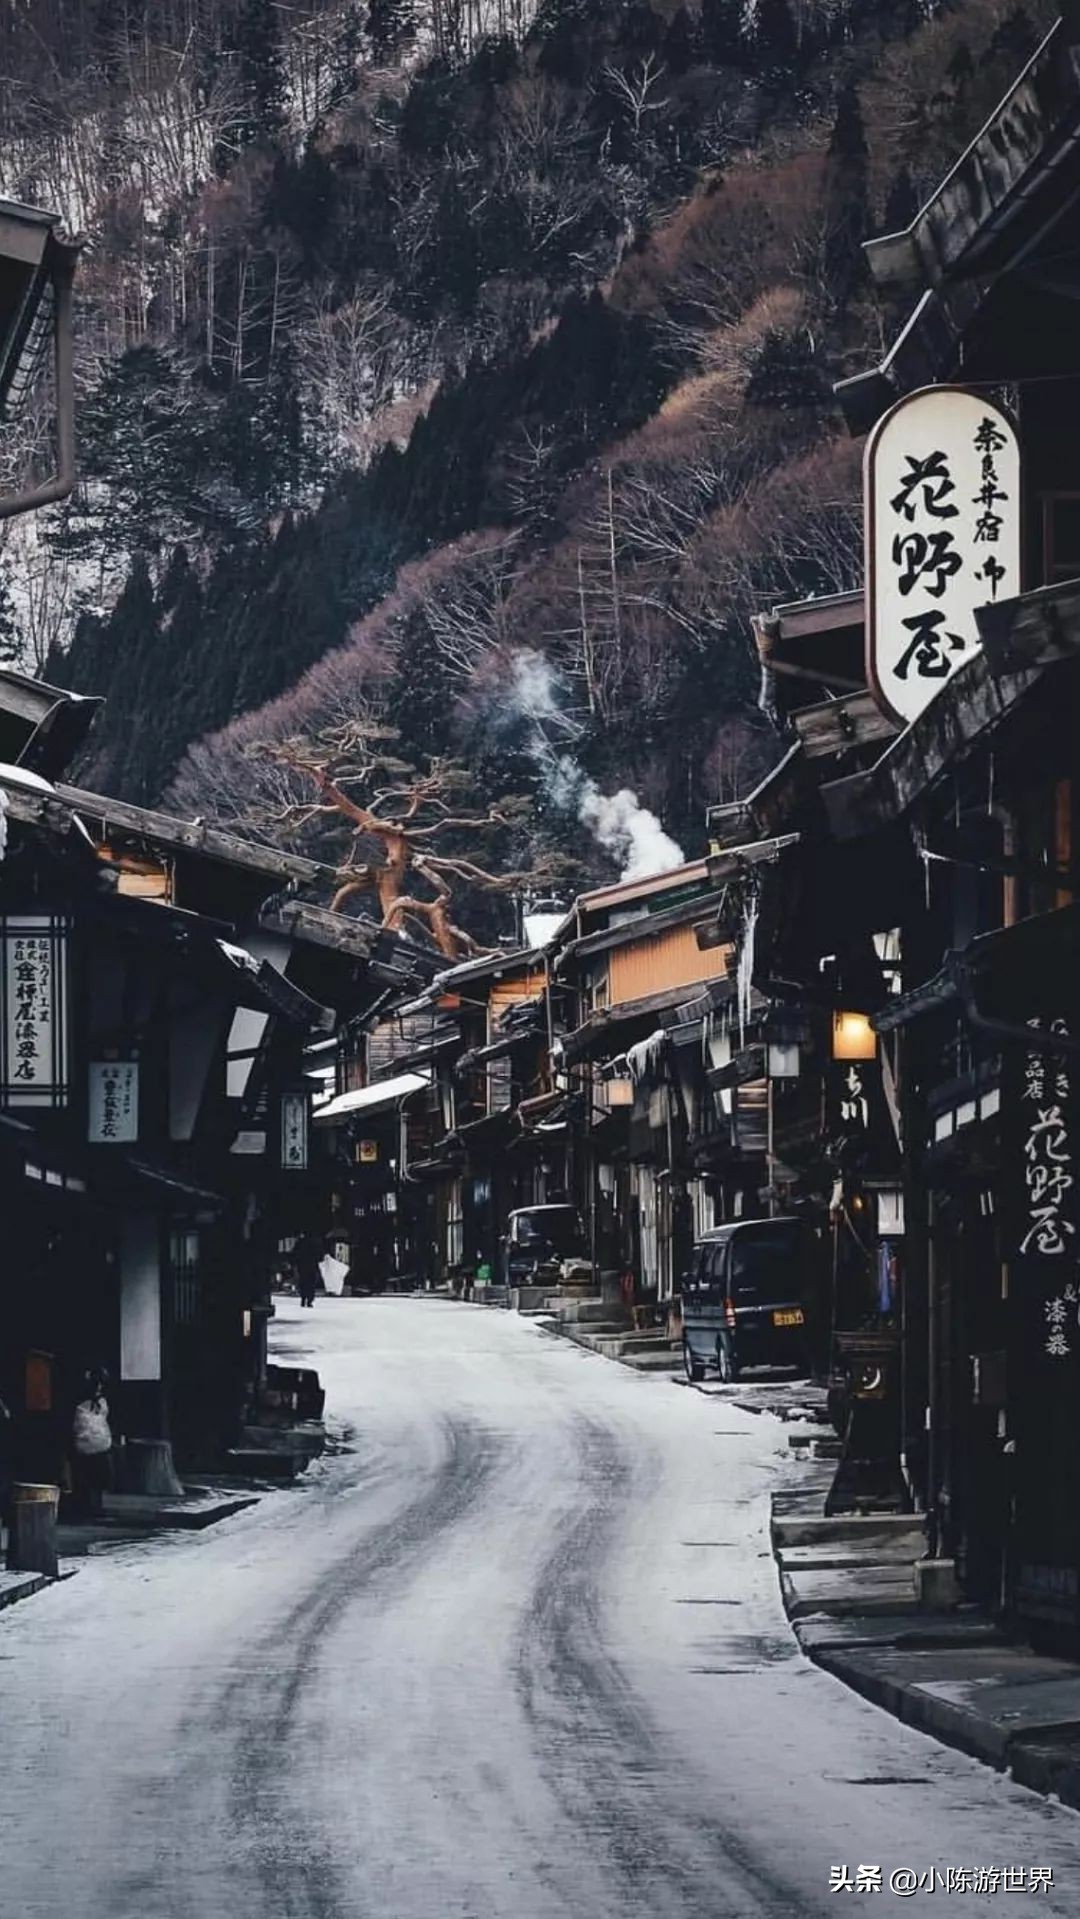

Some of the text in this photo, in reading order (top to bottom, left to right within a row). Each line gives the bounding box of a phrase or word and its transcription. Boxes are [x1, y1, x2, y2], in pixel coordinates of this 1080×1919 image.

[889, 450, 966, 681] 花野屋
[1019, 1104, 1076, 1255] 花野屋
